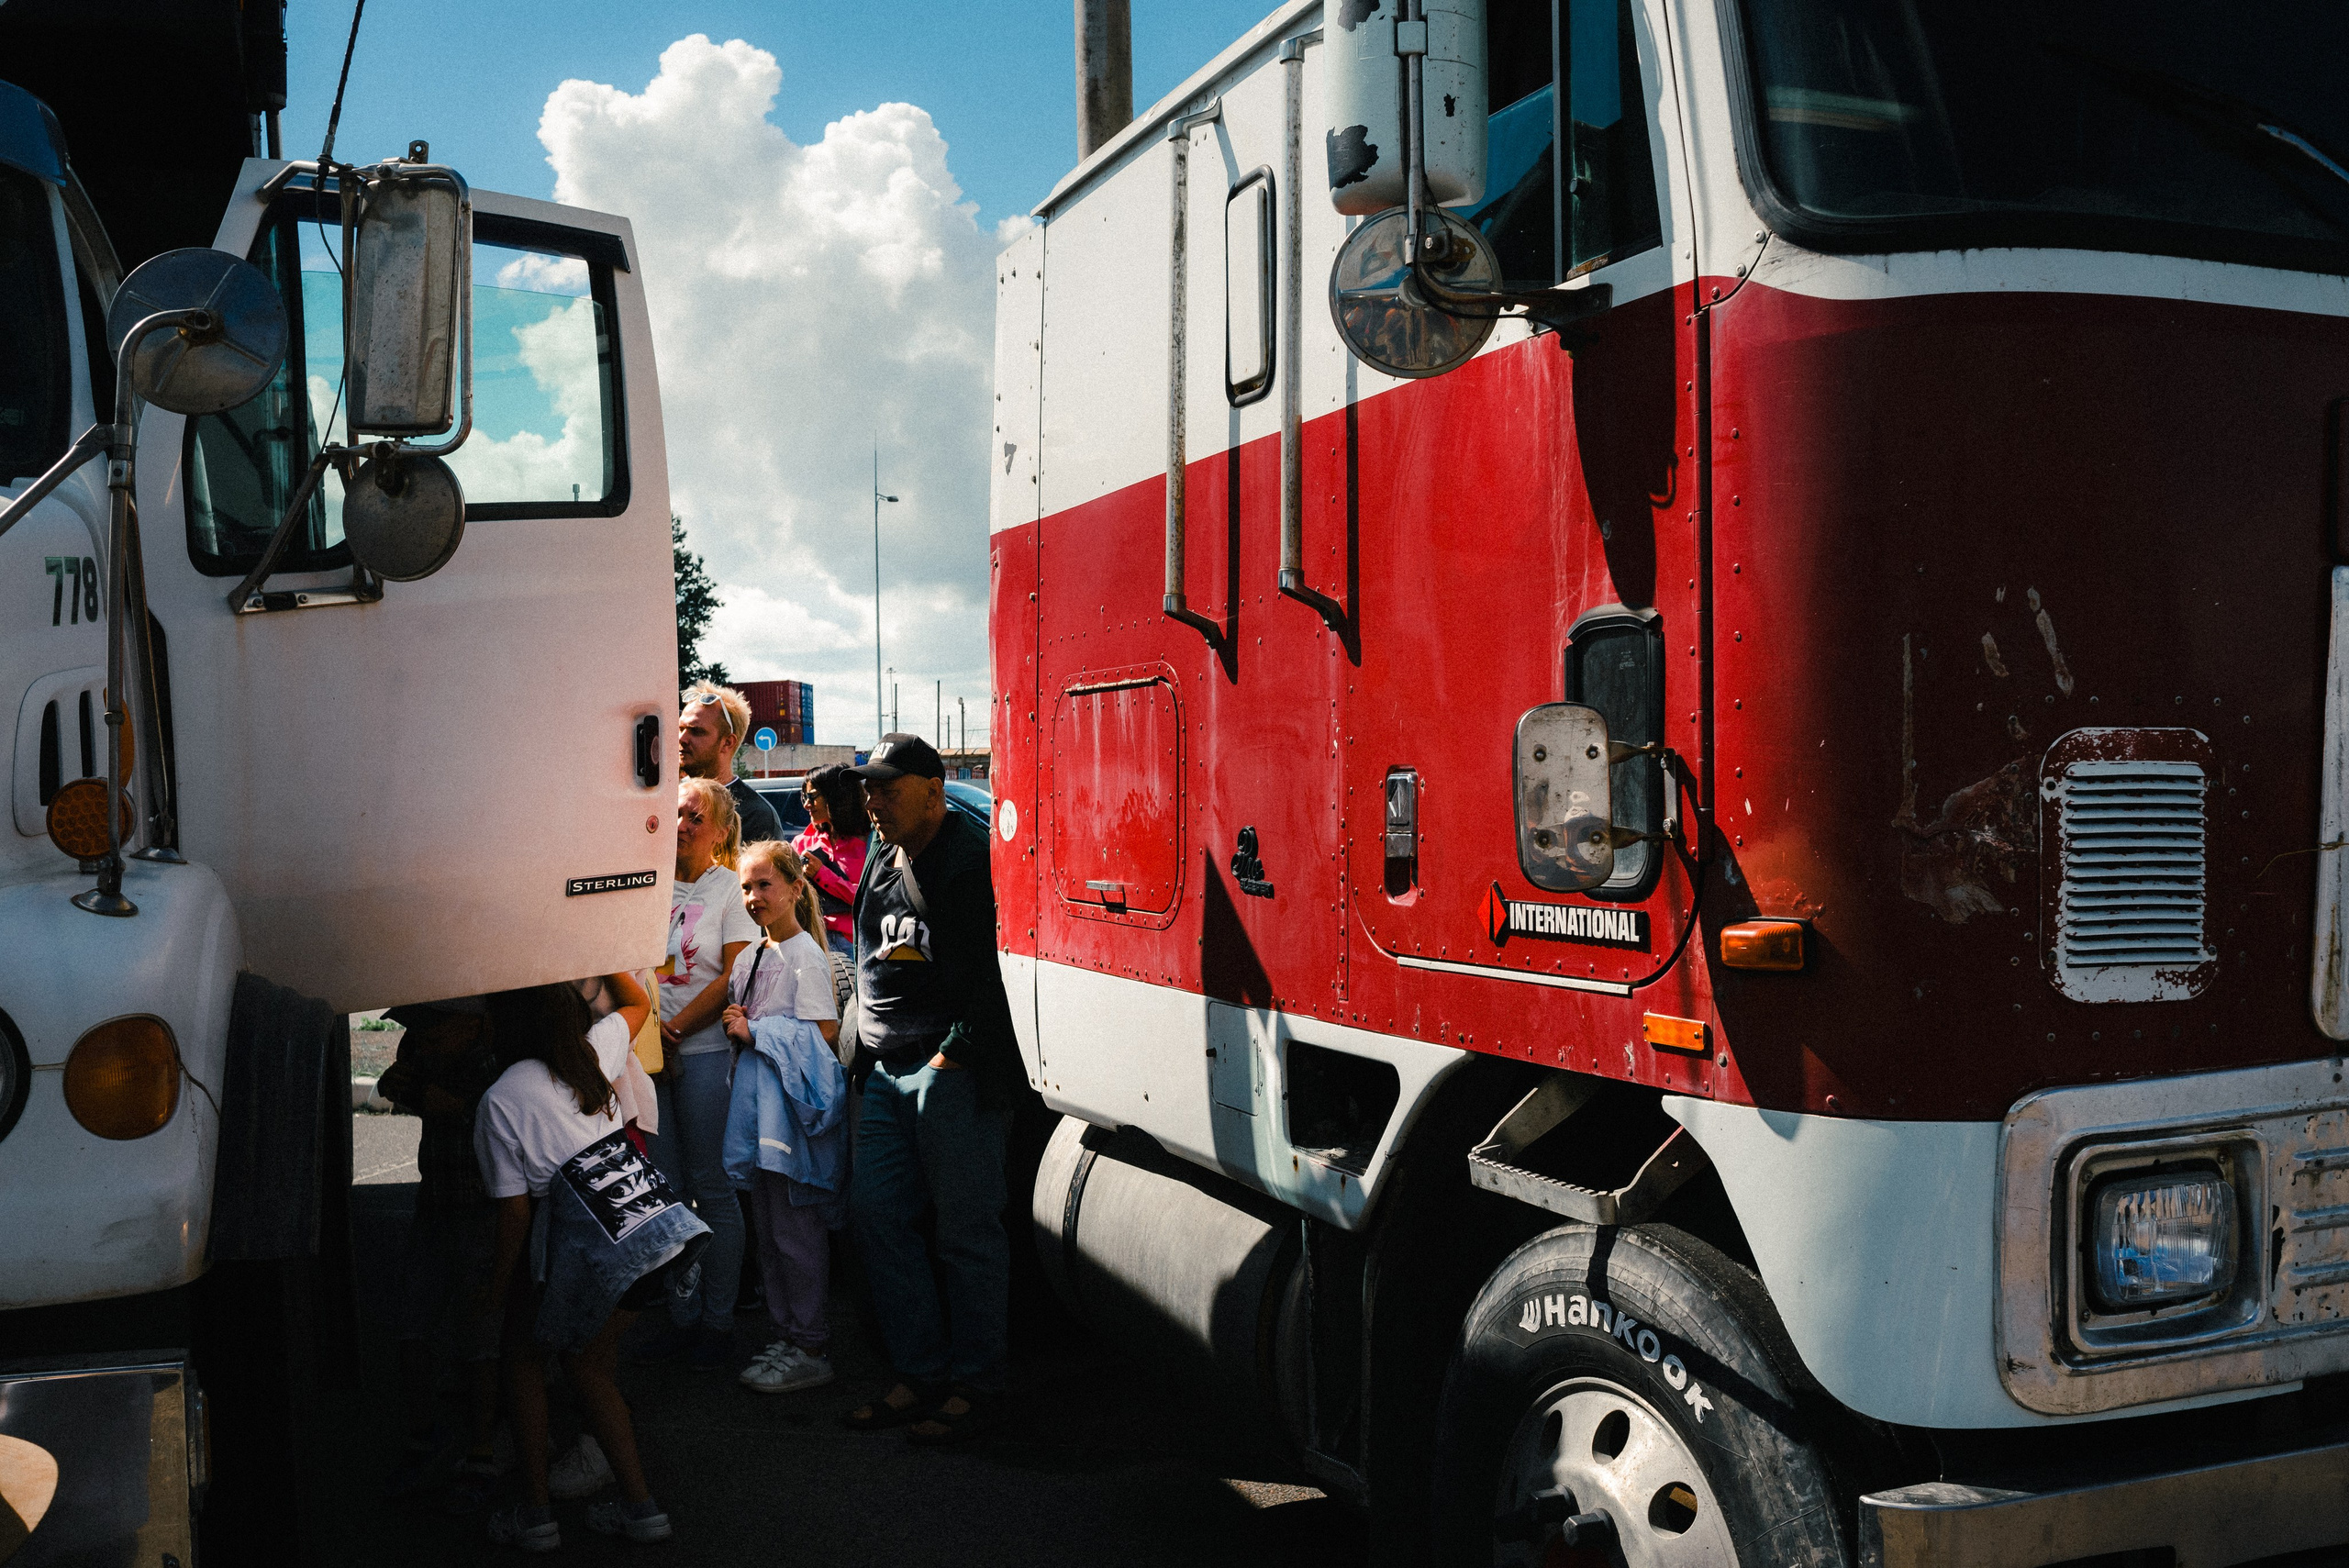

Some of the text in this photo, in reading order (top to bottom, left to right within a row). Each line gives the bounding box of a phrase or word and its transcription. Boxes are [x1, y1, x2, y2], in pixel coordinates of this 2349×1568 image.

[44, 556, 99, 627] 778
[573, 873, 654, 892] STERLING
[1509, 902, 1640, 942] INTERNATIONAL
